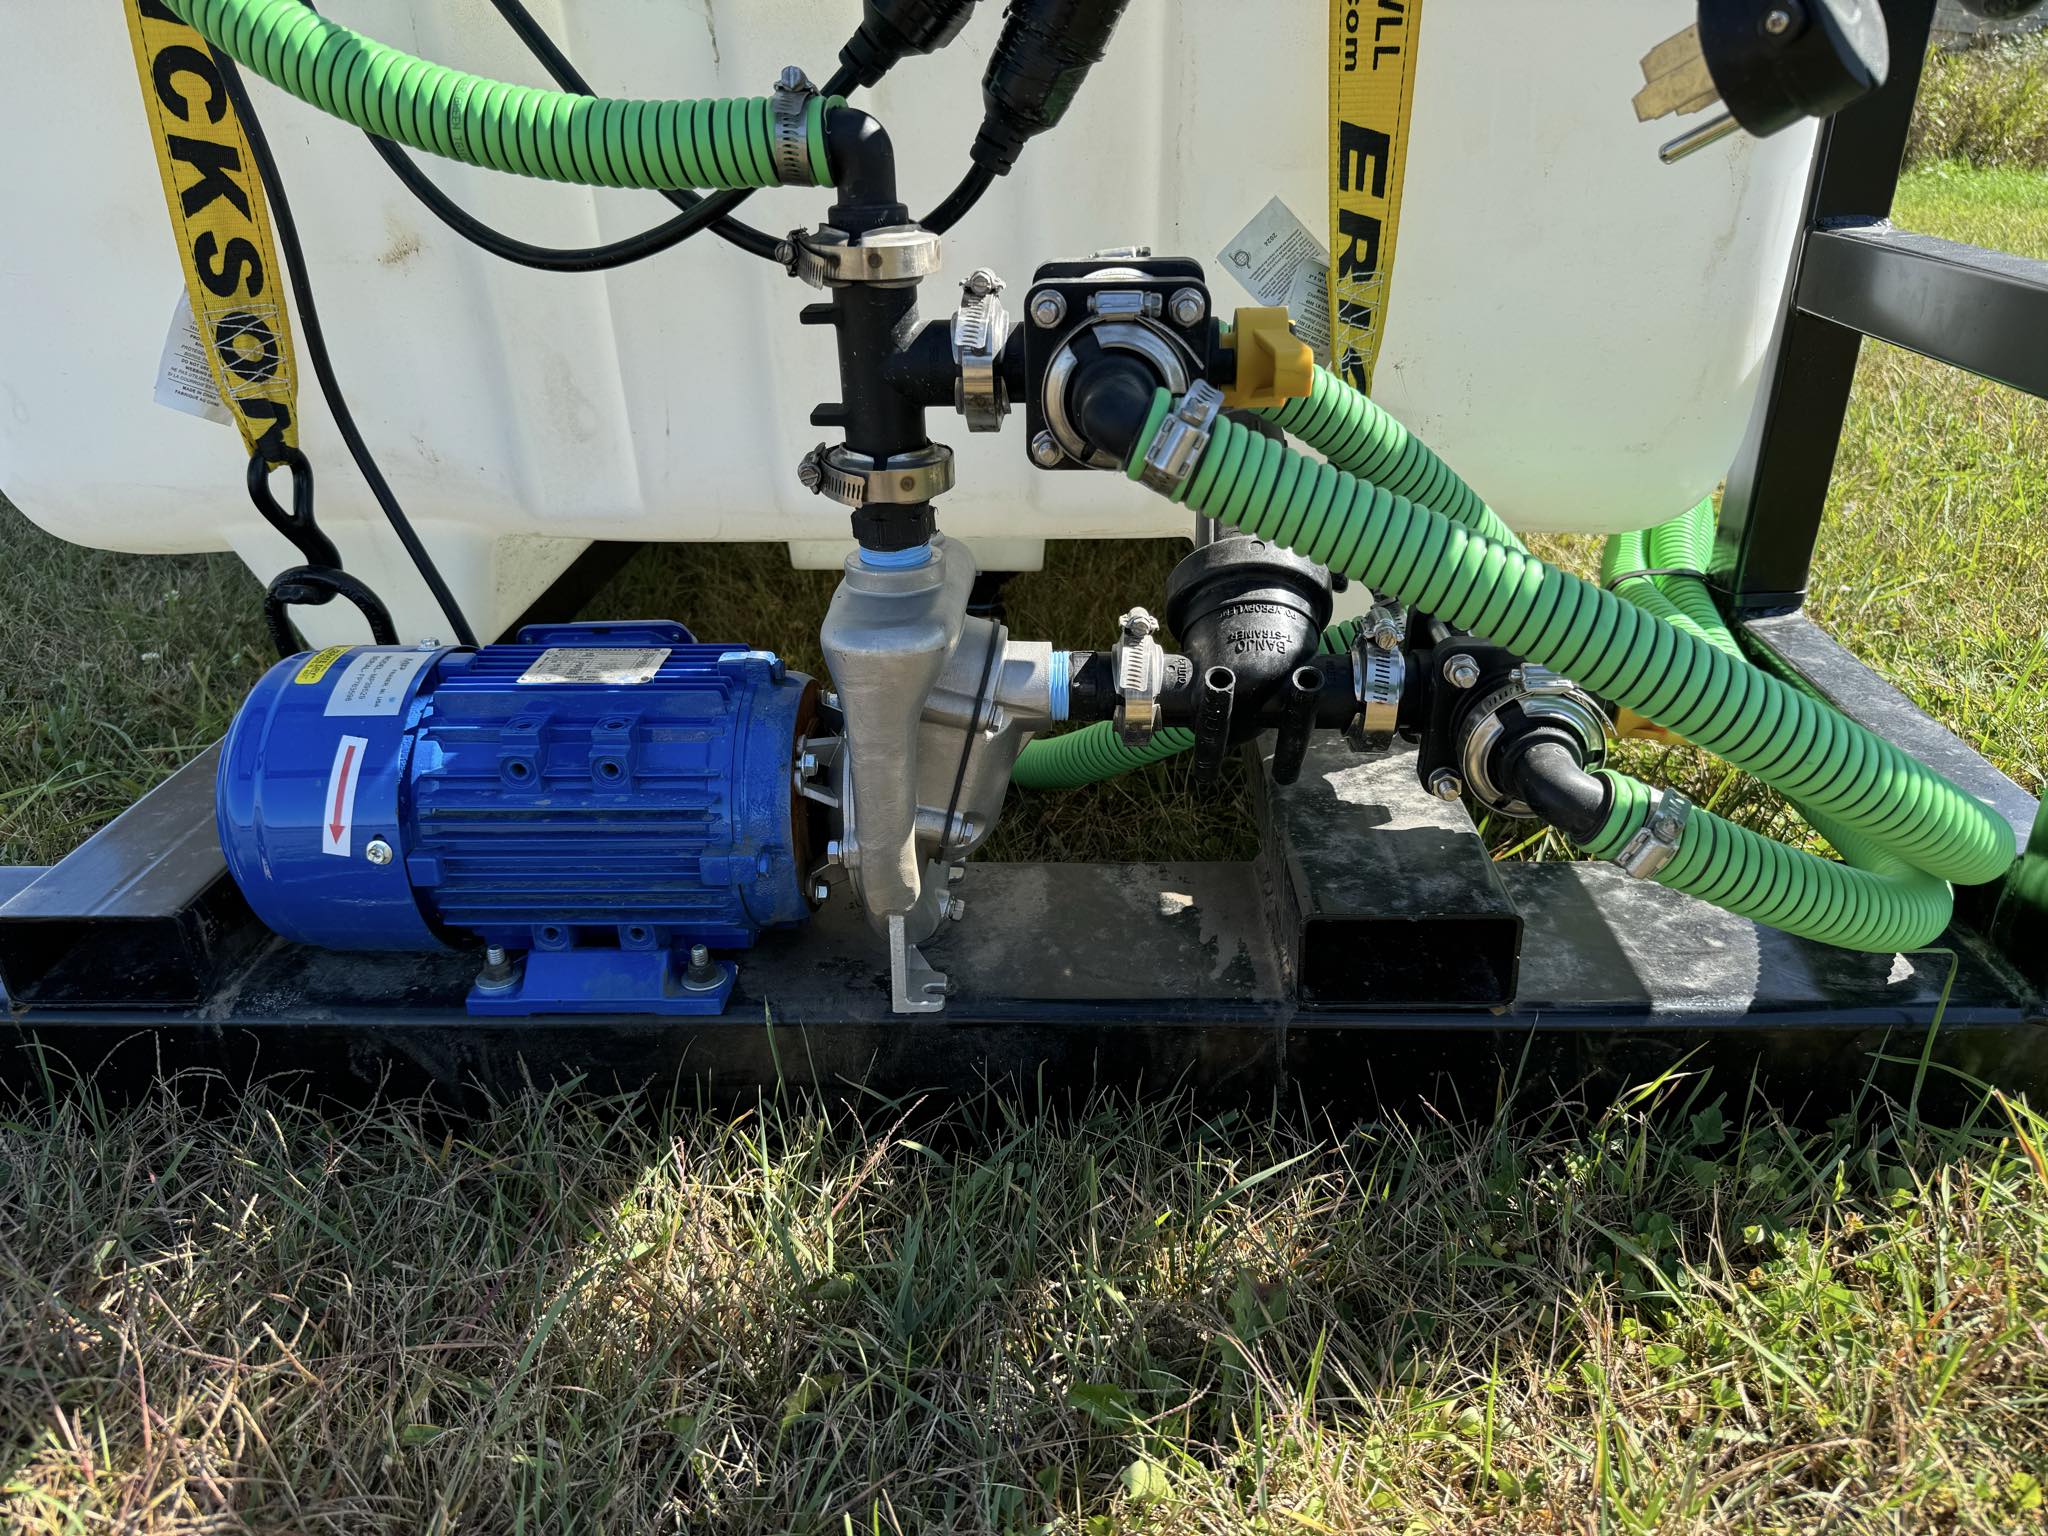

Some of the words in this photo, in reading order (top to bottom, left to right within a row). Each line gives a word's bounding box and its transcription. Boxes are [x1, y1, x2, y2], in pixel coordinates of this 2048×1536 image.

[1345, 0, 1360, 71] om
[1263, 232, 1278, 247] 2024
[182, 385, 196, 393] MADE
[1229, 630, 1292, 643] T-STRAINER
[1234, 639, 1286, 654] BANJO
